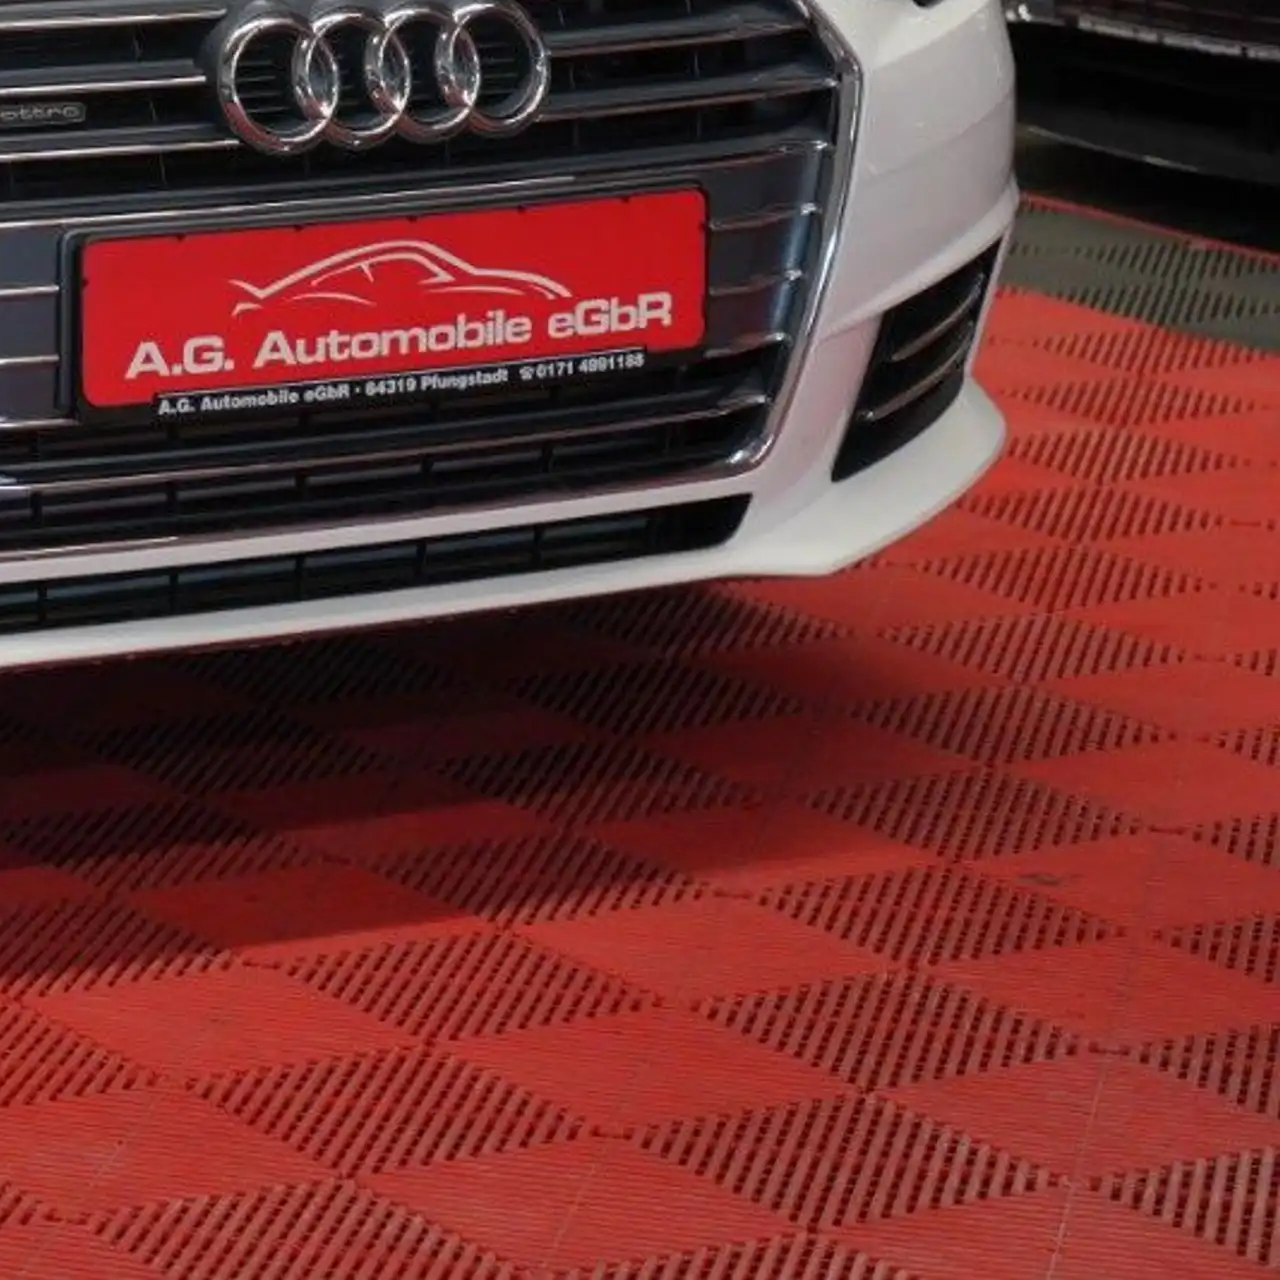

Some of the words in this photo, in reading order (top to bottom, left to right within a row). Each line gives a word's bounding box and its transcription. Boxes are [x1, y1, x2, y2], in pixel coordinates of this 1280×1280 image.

[125, 335, 235, 379] A.G.
[252, 309, 532, 368] Automobile
[547, 291, 672, 338] eGbR
[158, 398, 196, 415] A.G.
[200, 389, 299, 411] Automobile
[303, 384, 351, 402] eGbR
[420, 370, 508, 391] Pfungstadt
